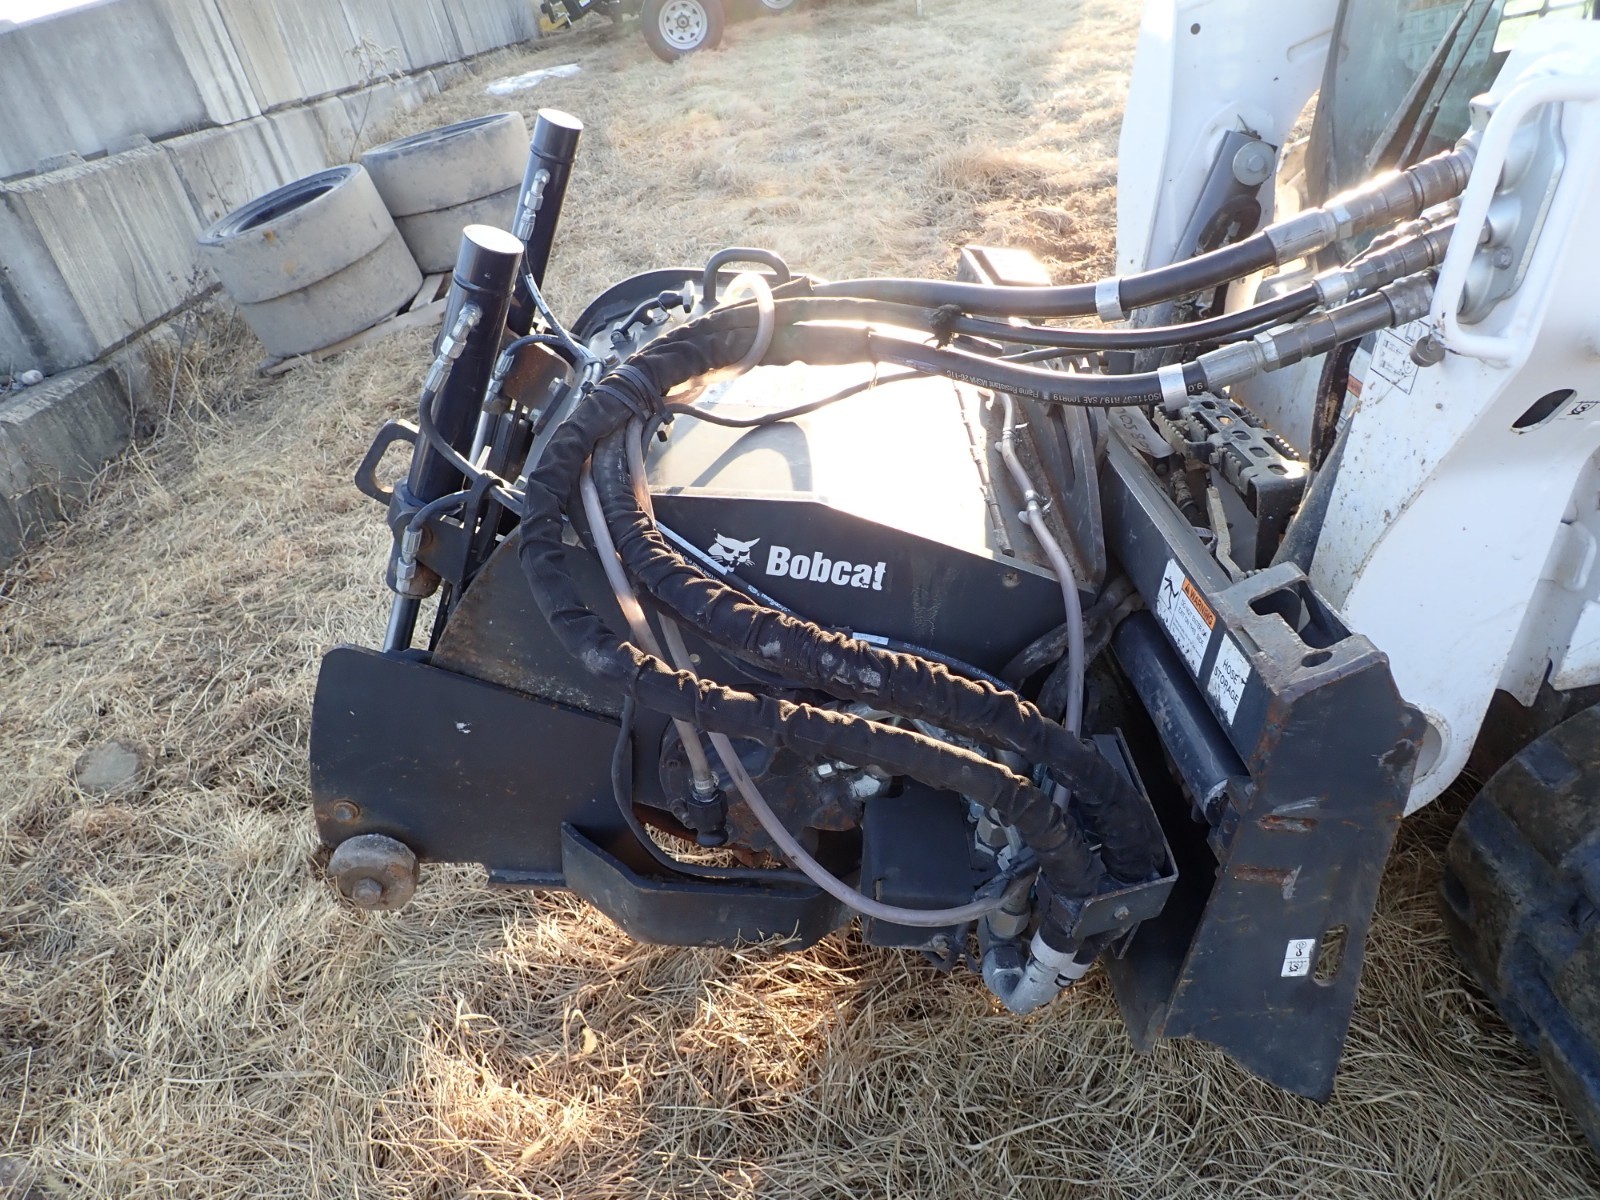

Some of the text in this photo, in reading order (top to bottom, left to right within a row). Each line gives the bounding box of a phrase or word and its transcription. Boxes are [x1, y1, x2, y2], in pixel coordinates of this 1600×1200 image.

[988, 380, 1018, 394] Resistant
[1018, 388, 1039, 398] Flame
[1083, 396, 1098, 404] SAE
[765, 545, 887, 591] Bobcat
[1189, 590, 1213, 626] WARNING
[1195, 632, 1204, 648] SIDE
[1222, 659, 1239, 685] HOSE
[1213, 665, 1239, 706] STORAGE
